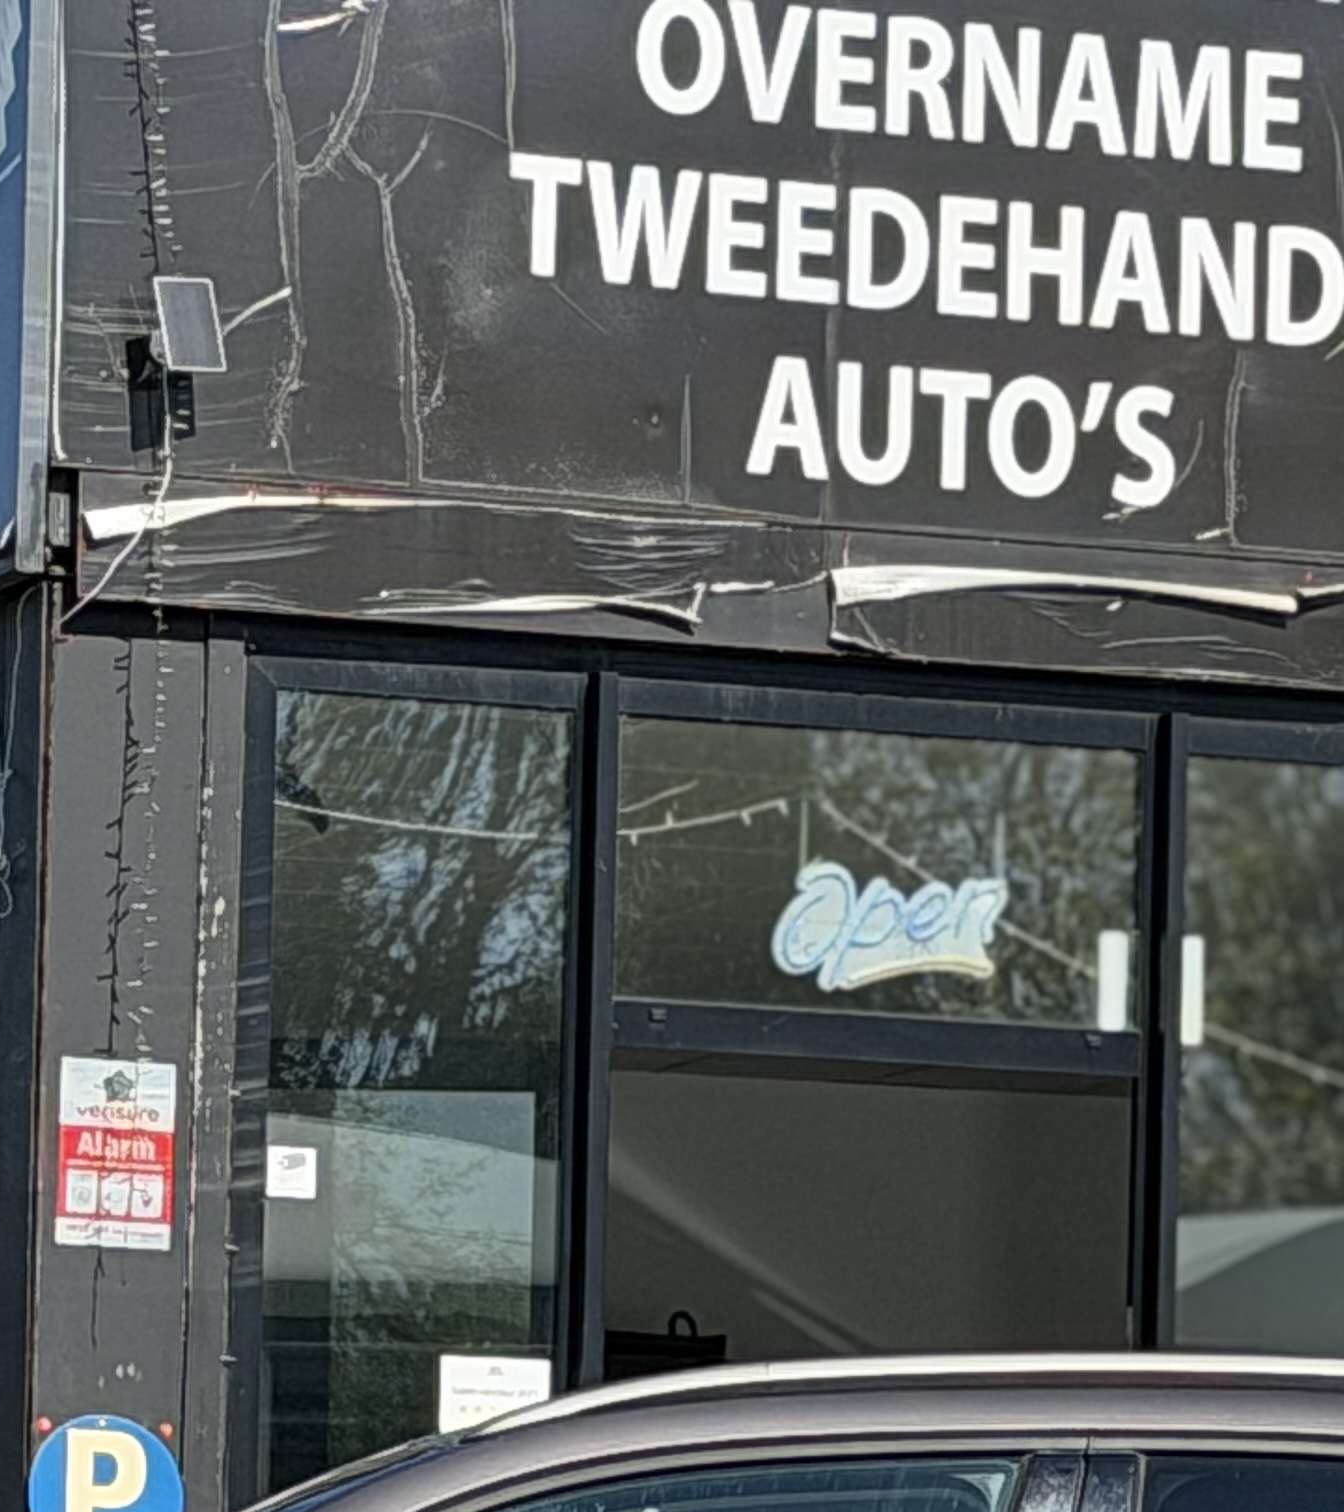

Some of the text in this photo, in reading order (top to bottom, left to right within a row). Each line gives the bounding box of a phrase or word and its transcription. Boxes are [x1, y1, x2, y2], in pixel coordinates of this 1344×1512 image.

[635, 0, 1304, 173] OVERNAME
[745, 355, 1176, 510] AUTO'S
[771, 862, 1009, 991] Open
[76, 1131, 157, 1161] Alarm
